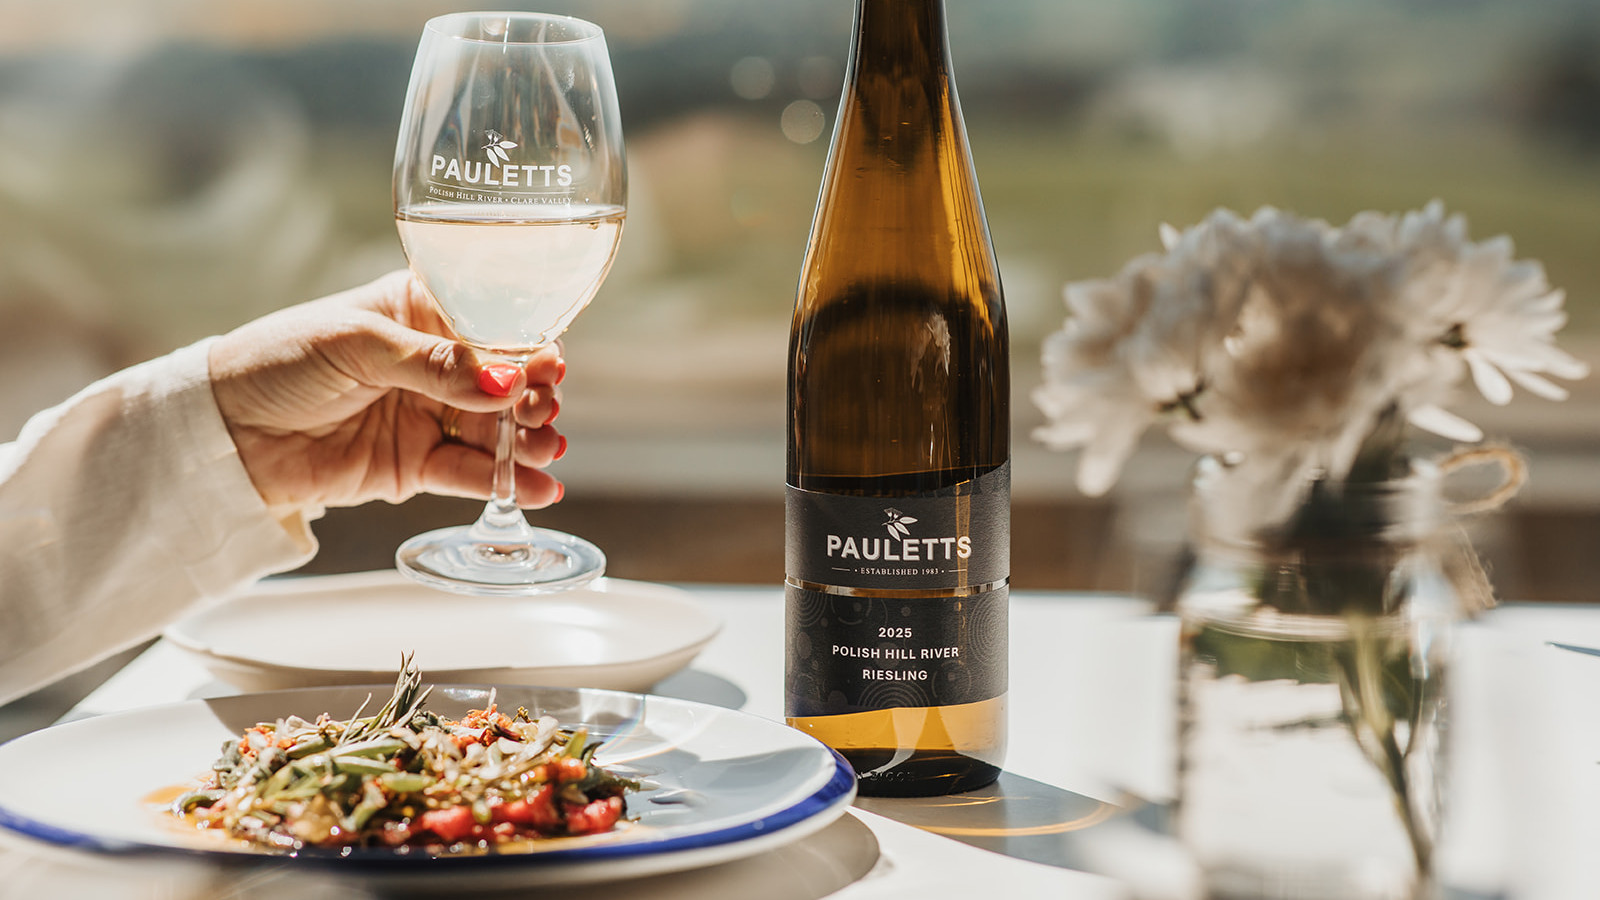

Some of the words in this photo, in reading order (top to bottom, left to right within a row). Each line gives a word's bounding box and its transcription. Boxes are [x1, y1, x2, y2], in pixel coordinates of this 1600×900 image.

[431, 154, 572, 187] PAULETTS
[826, 534, 972, 562] PAULETTS
[860, 567, 919, 576] ESTABLISHED
[878, 627, 912, 638] 2025
[832, 645, 880, 659] POLISH
[885, 649, 916, 660] HILL
[920, 647, 959, 659] RIVER
[862, 669, 928, 681] RIESLING
